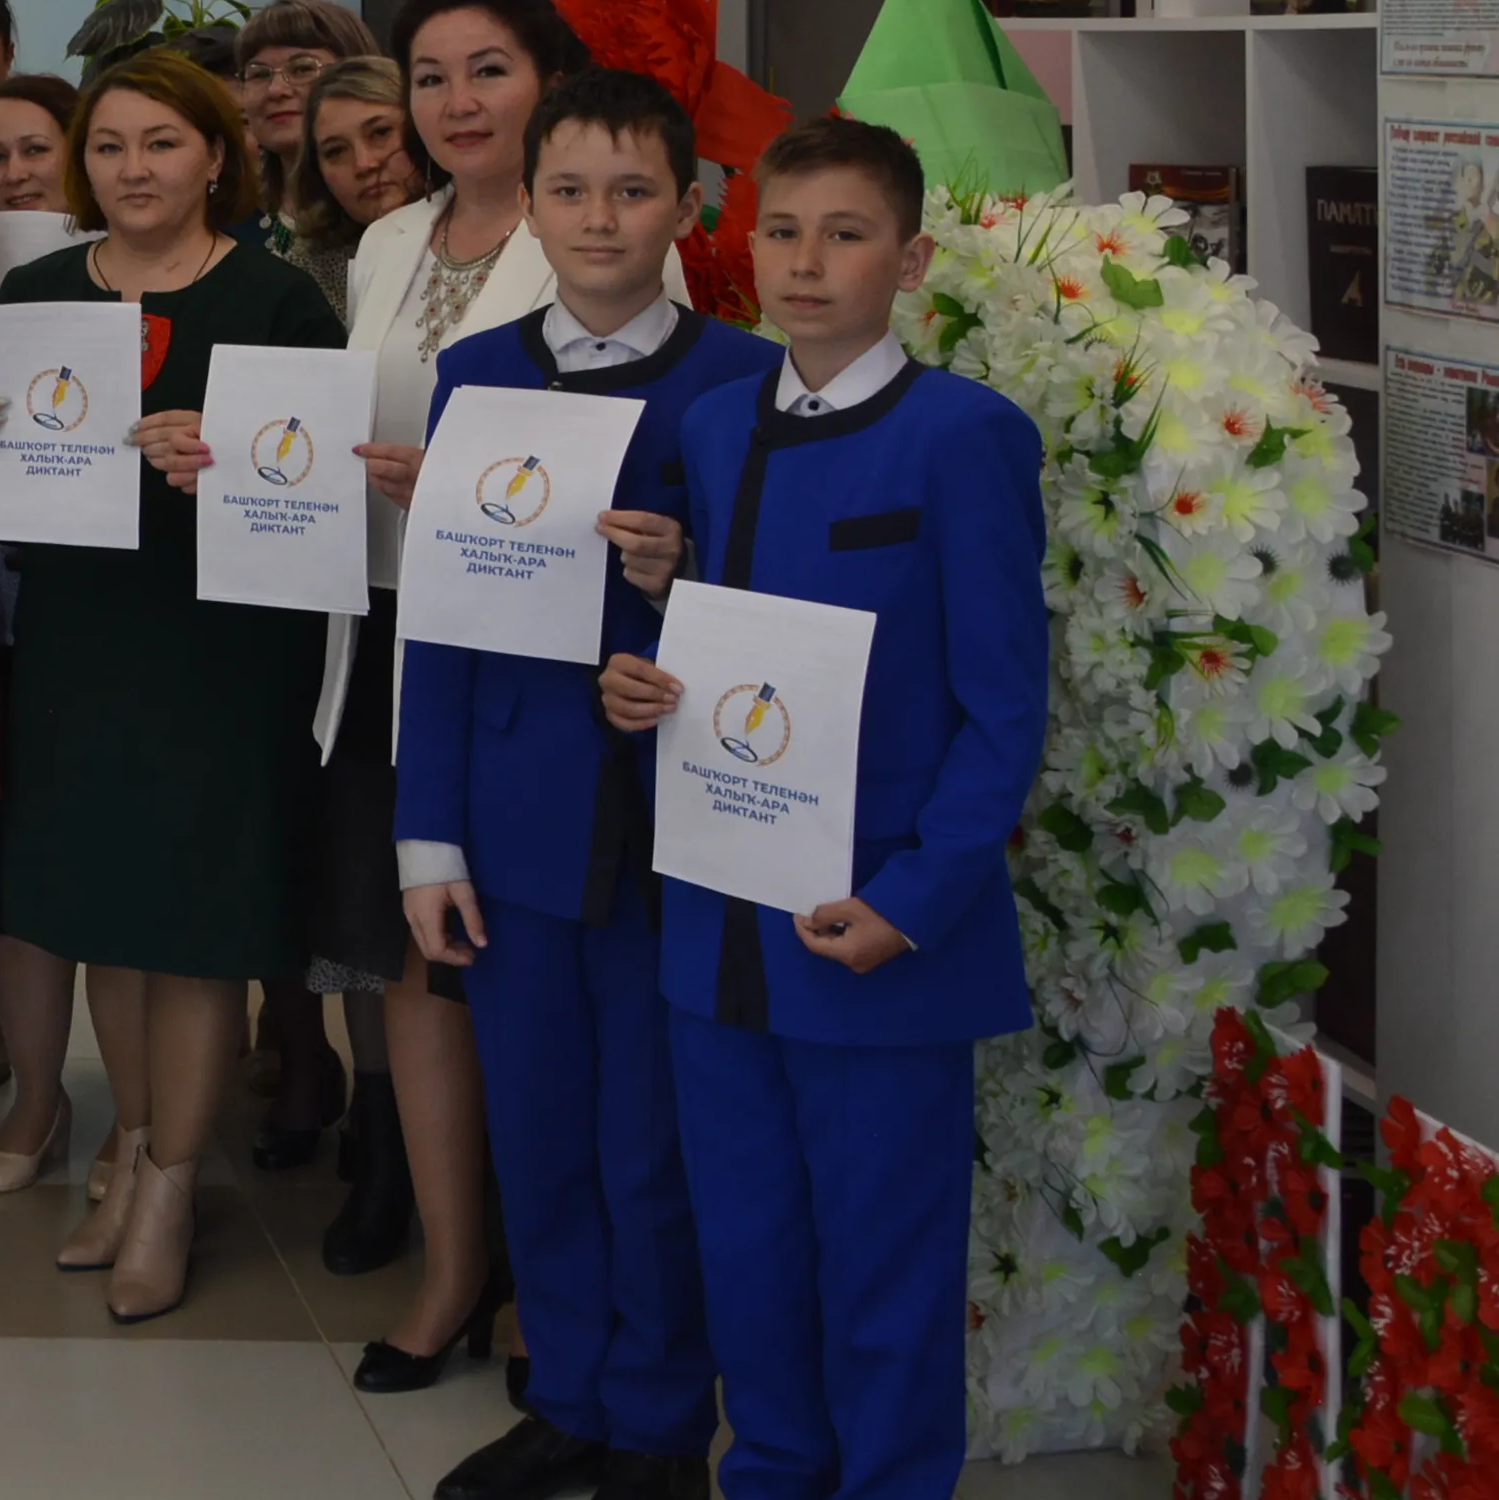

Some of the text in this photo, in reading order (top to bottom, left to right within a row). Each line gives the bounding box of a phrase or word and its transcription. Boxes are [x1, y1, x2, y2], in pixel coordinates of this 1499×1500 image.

[250, 522, 306, 536] ДИКТАНТ
[435, 529, 576, 559] БАШҠОРТ ТЕЛЕНӘН
[460, 548, 547, 568] ХАЛЫҠ-АРА
[466, 562, 533, 580] ДИКТАНТ
[682, 760, 819, 806] БАШҠОРТ ТЕЛЕНӘН
[705, 783, 790, 815] ХАЛЫҠ-АРА
[712, 799, 777, 826] ДИКТАНТ
